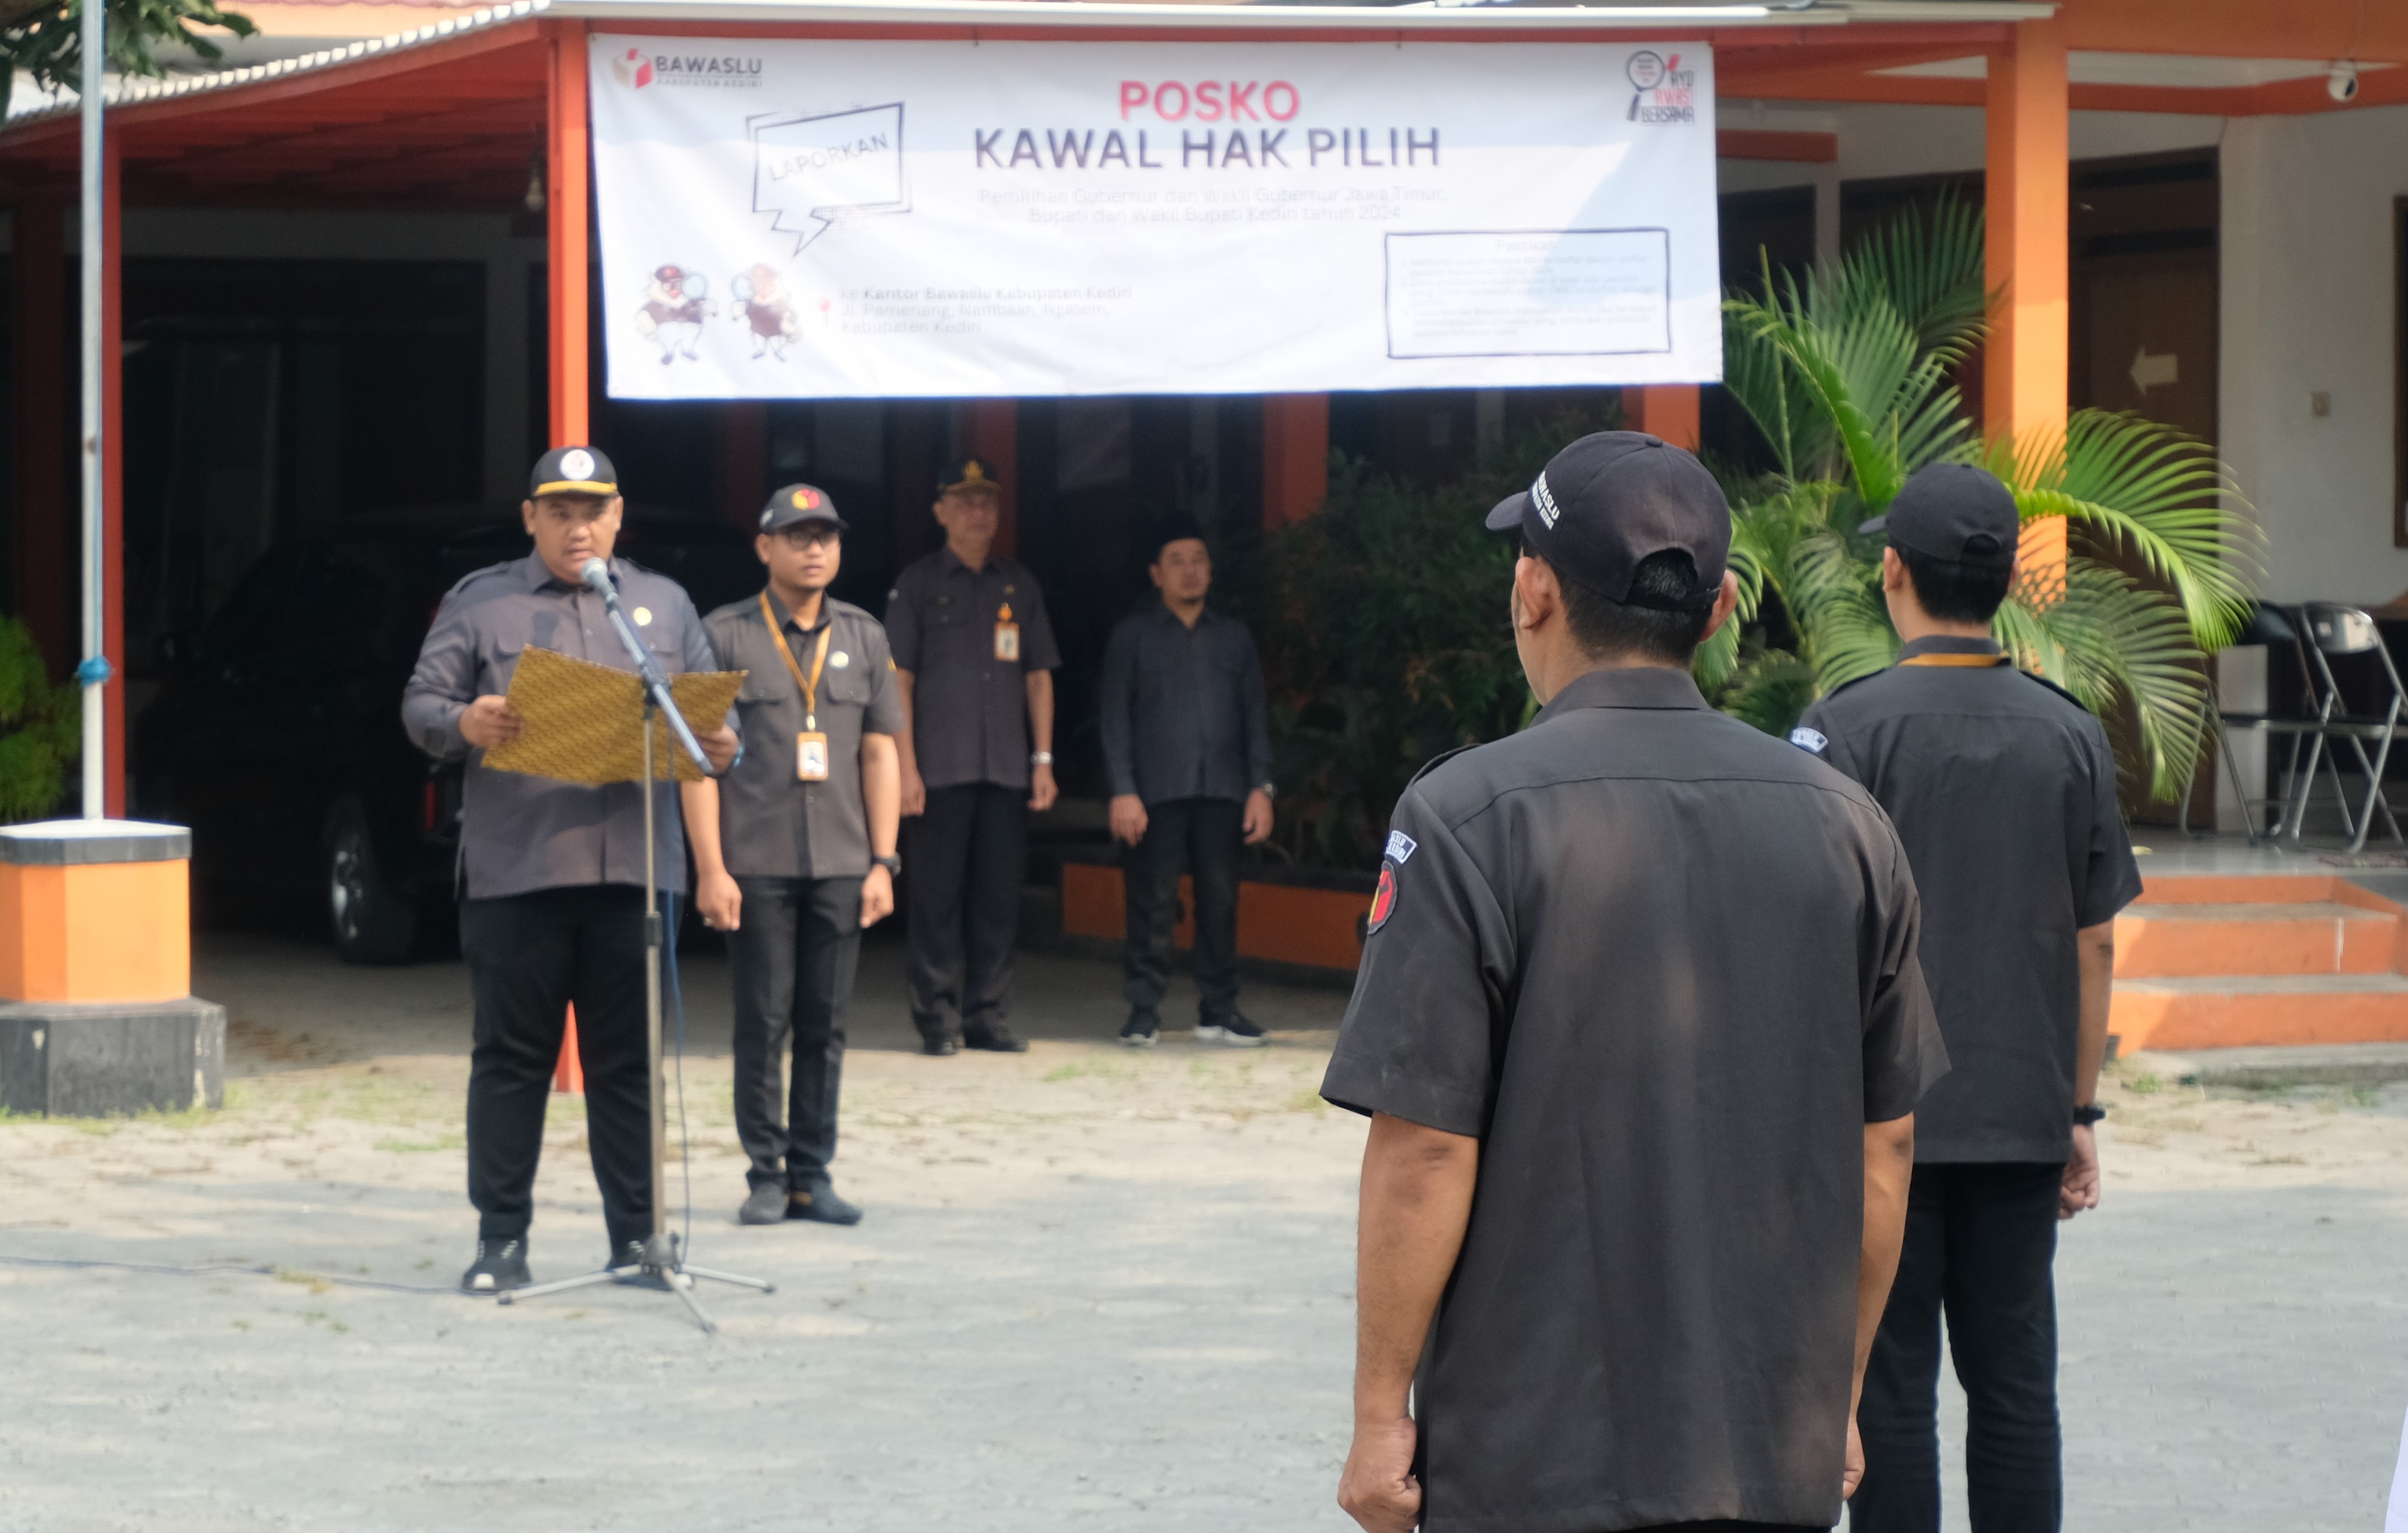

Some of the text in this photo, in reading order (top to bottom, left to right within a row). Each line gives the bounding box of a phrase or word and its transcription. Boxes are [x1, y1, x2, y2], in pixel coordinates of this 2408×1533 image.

[656, 55, 762, 74] BAWASLU
[1120, 79, 1300, 122] POSKO
[768, 131, 889, 181] LAPORKAN
[974, 126, 1440, 169] KAWAL HAK PILIH
[980, 185, 1448, 204] Pemilihan Gubernur dan Wakil Gubernur Jawa Timur,
[1029, 207, 1088, 225] Bupati
[1094, 207, 1127, 222] dan
[1185, 207, 1242, 225] Bupati
[1247, 206, 1299, 221] Kediri
[1302, 205, 1354, 221] tahun
[1358, 204, 1401, 219] 2024
[841, 285, 1132, 302] ke Kantor Bawaslu Kabupaten Kediri
[864, 302, 955, 320] Pamenang,
[1044, 302, 1111, 319] Ngasem,
[843, 319, 982, 335] Kabupaten Kediri
